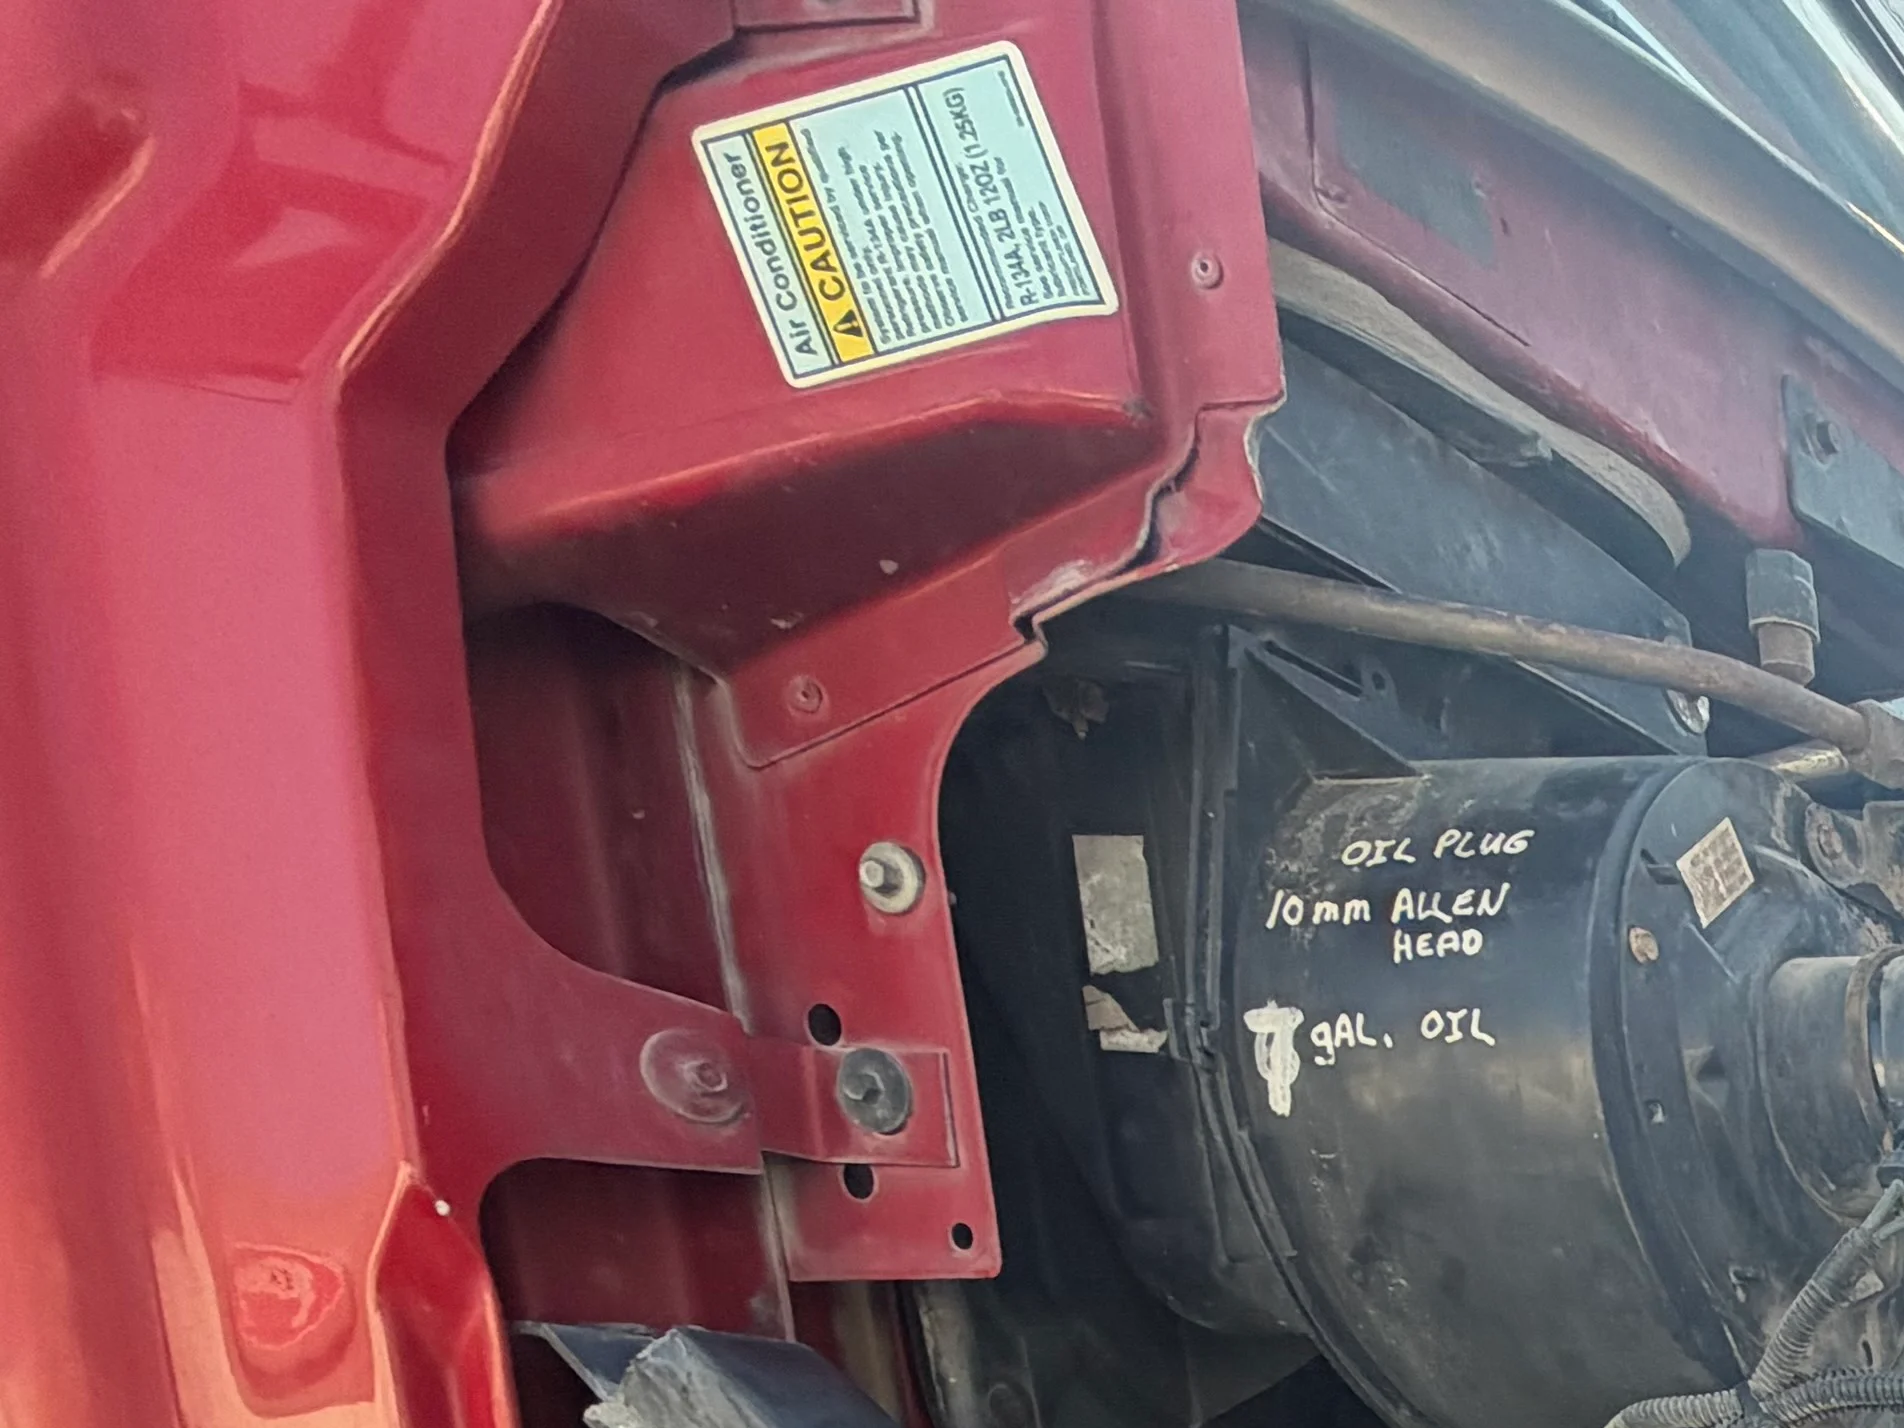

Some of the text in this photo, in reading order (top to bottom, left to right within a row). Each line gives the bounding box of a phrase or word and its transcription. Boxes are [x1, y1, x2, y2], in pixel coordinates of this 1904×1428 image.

[942, 87, 988, 158] (1.25KG)
[764, 141, 845, 301] CAUTION
[987, 208, 1015, 242] 2LB
[722, 152, 817, 355] Air Conditioner
[1341, 829, 1535, 868] OIL PLUG
[1390, 881, 1511, 924] ALLEN
[1393, 929, 1483, 964] HEAD
[1420, 1007, 1496, 1046] OIL
